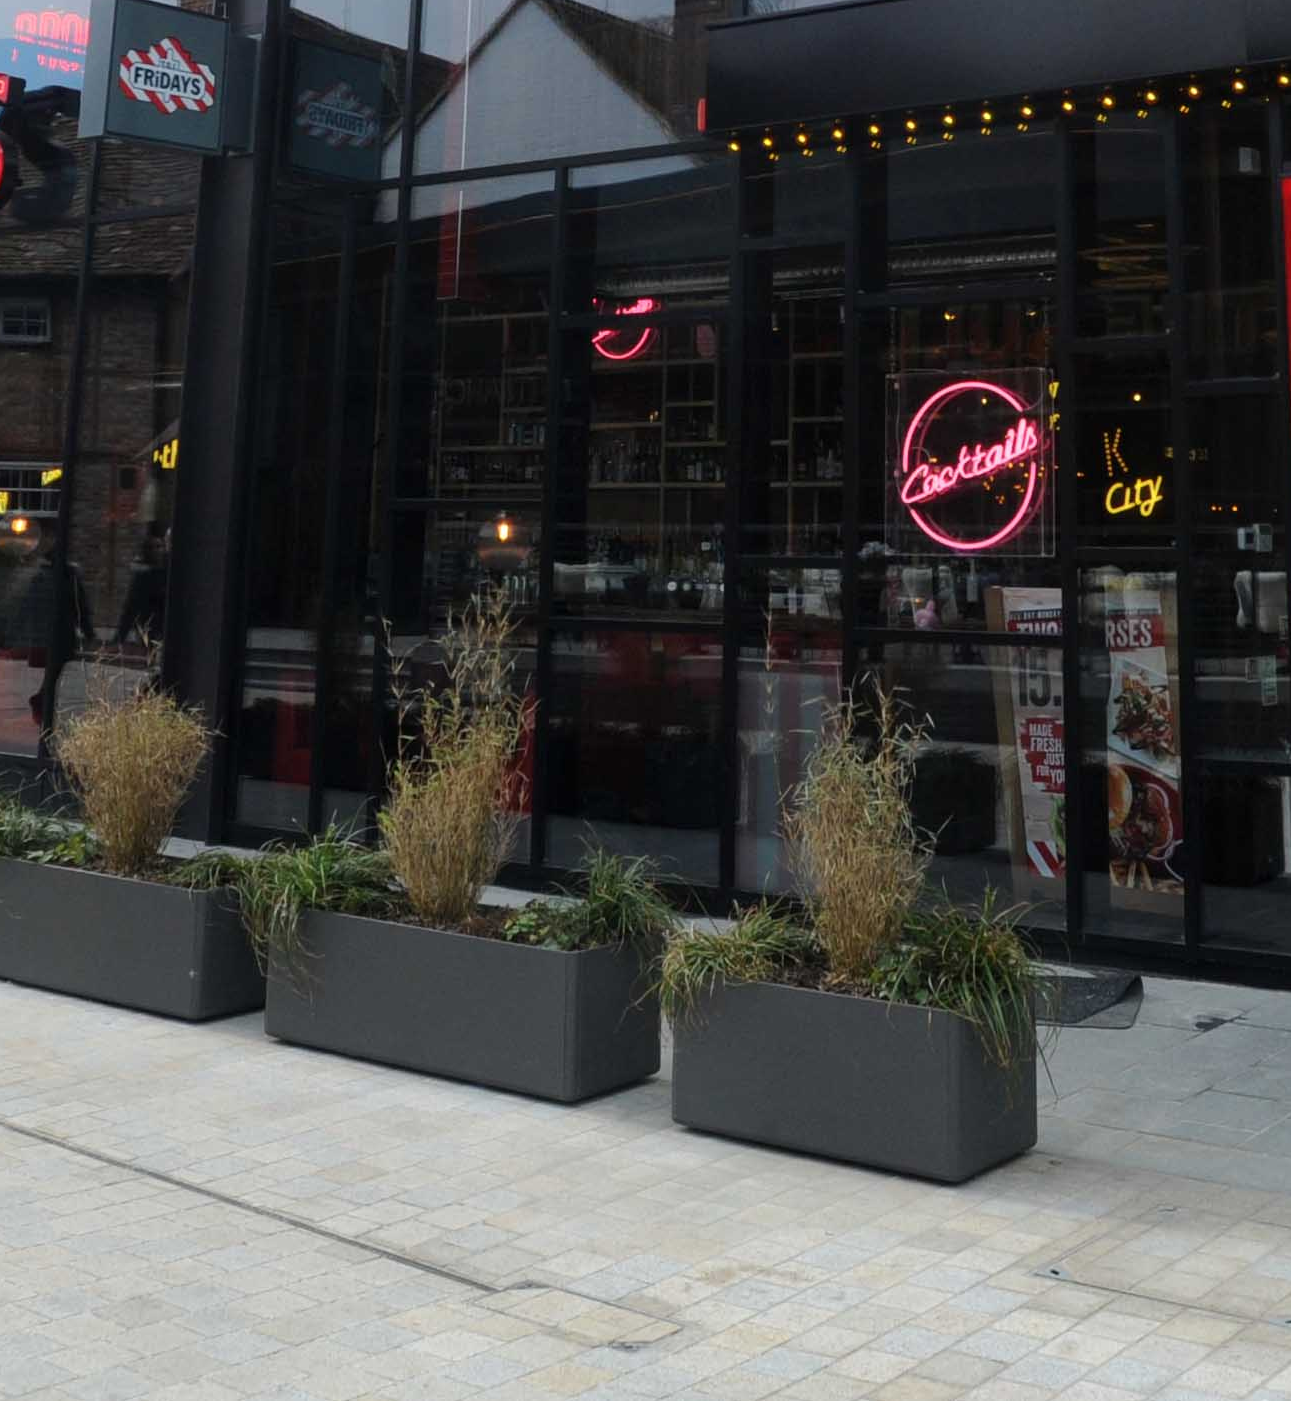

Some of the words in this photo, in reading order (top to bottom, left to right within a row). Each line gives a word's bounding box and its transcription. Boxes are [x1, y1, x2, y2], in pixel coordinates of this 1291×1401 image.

[900, 416, 1039, 506] Cocktails
[1104, 474, 1164, 518] City
[1029, 723, 1054, 737] MADE
